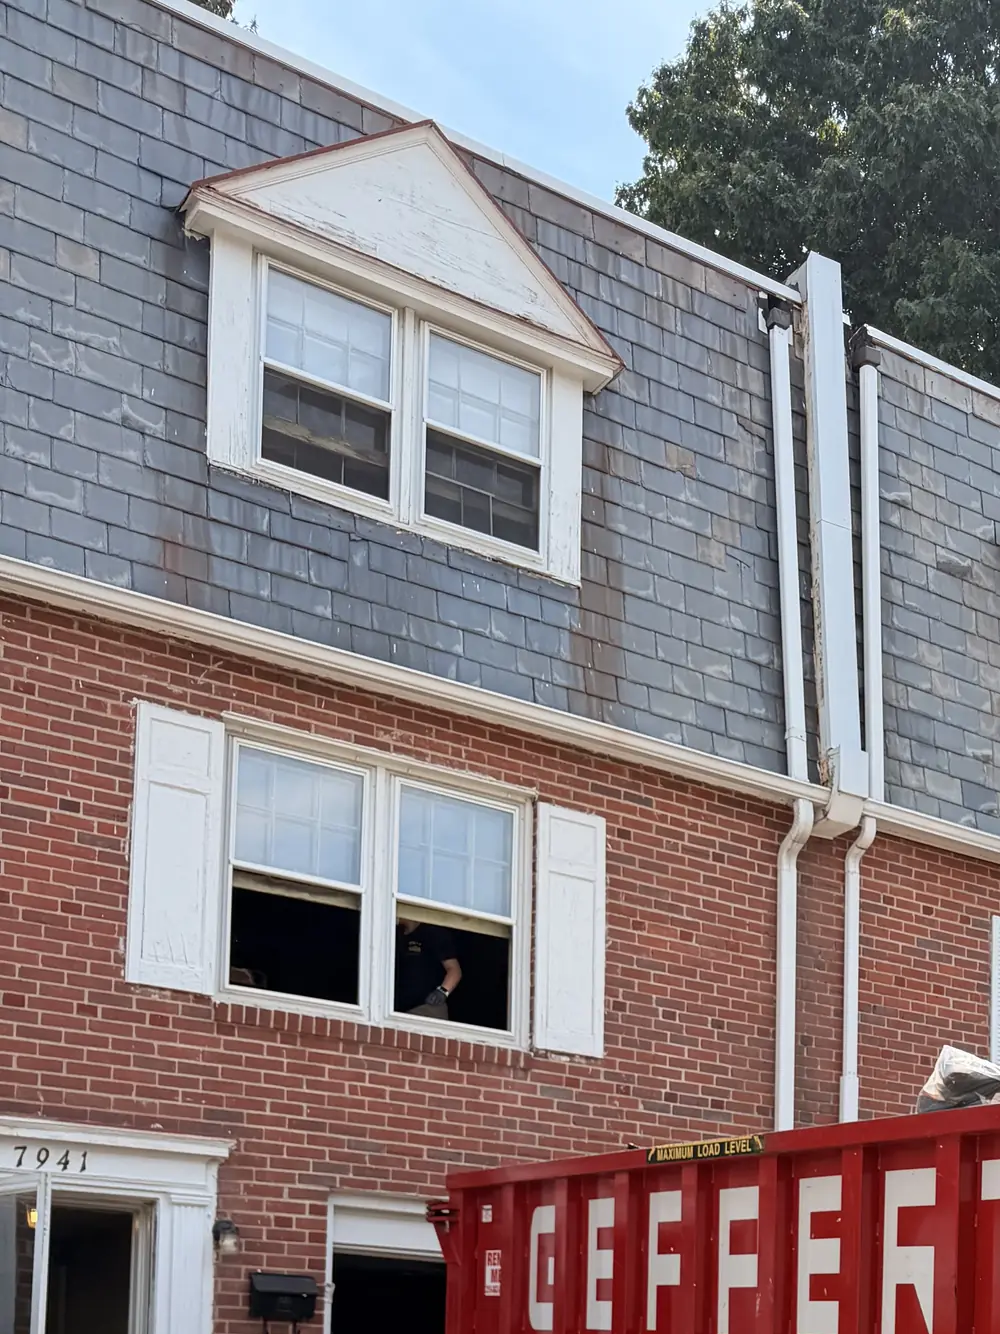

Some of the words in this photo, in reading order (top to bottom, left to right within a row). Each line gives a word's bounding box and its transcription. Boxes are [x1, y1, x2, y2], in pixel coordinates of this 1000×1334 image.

[14, 1146, 88, 1172] 7941
[656, 1147, 694, 1161] MAXIMUM
[697, 1143, 721, 1157] LOAD
[724, 1138, 752, 1154] LEVEL
